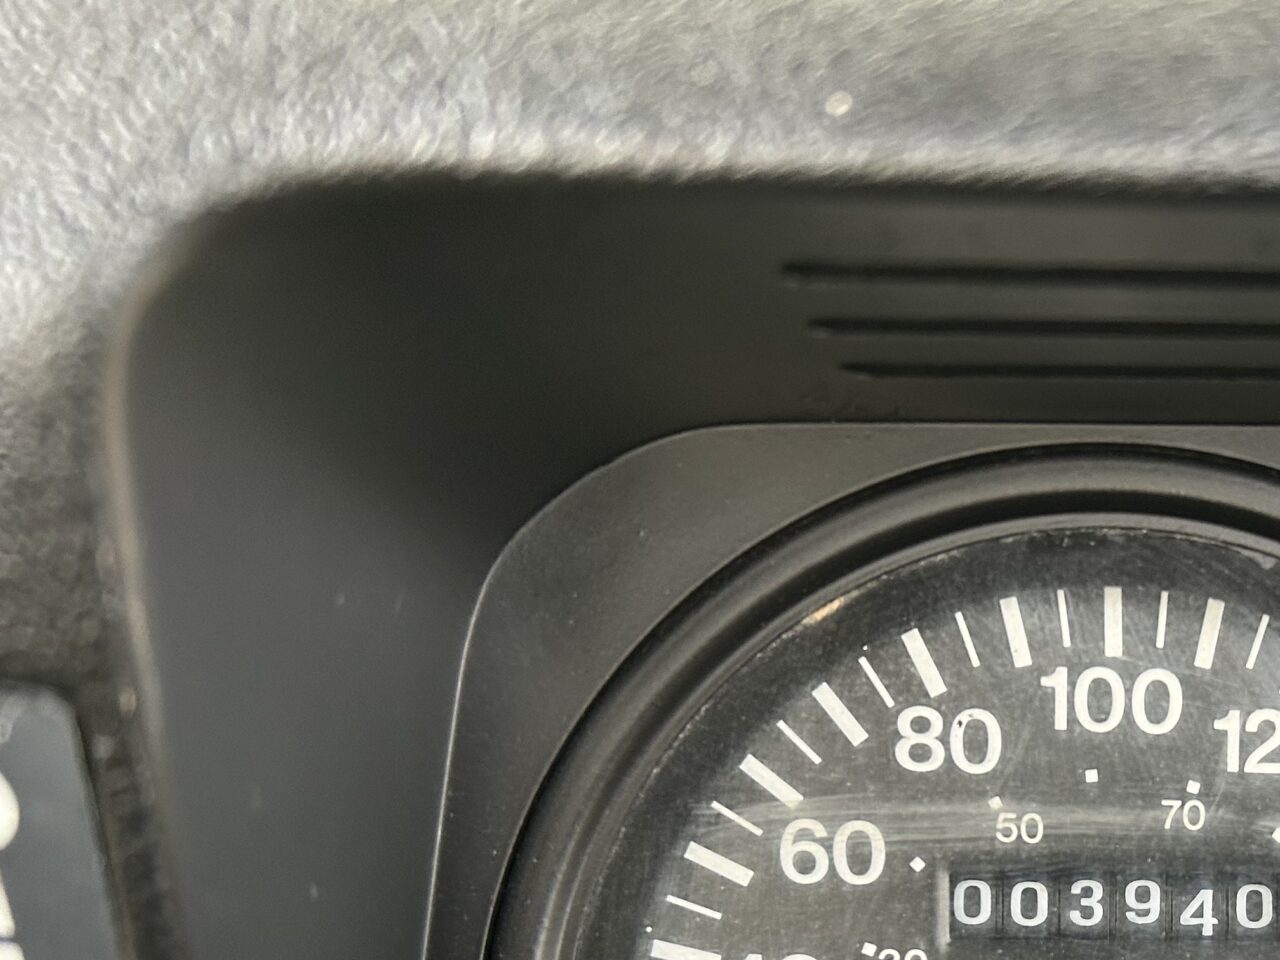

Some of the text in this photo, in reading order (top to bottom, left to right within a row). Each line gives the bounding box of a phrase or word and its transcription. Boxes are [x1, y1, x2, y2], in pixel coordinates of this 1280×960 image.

[1040, 667, 1183, 734] 100
[895, 706, 1001, 774] 80
[995, 813, 1044, 844] 50
[1161, 799, 1206, 831] 70
[780, 819, 885, 885] 60
